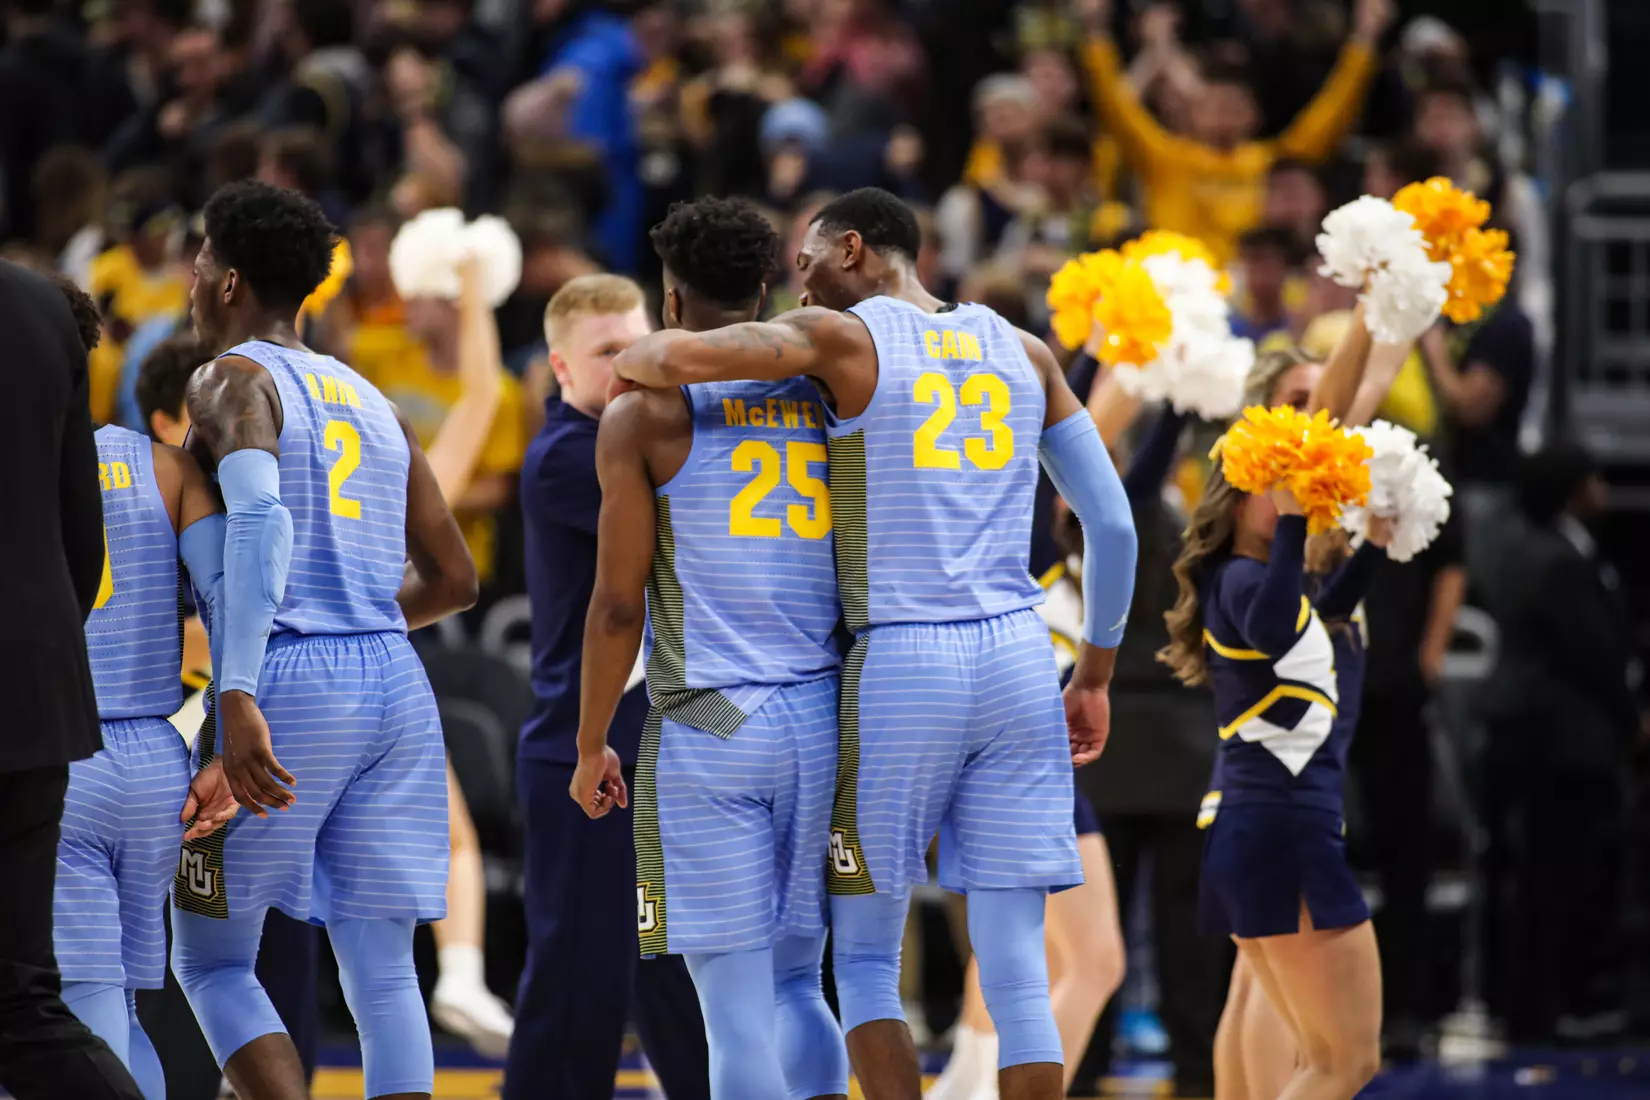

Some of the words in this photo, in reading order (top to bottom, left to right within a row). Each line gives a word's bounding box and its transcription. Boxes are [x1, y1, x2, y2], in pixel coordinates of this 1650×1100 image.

[924, 329, 982, 361] CAIN
[324, 420, 361, 520] 2
[913, 372, 1014, 470] 23
[729, 440, 833, 540] 25
[181, 848, 212, 897] MU
